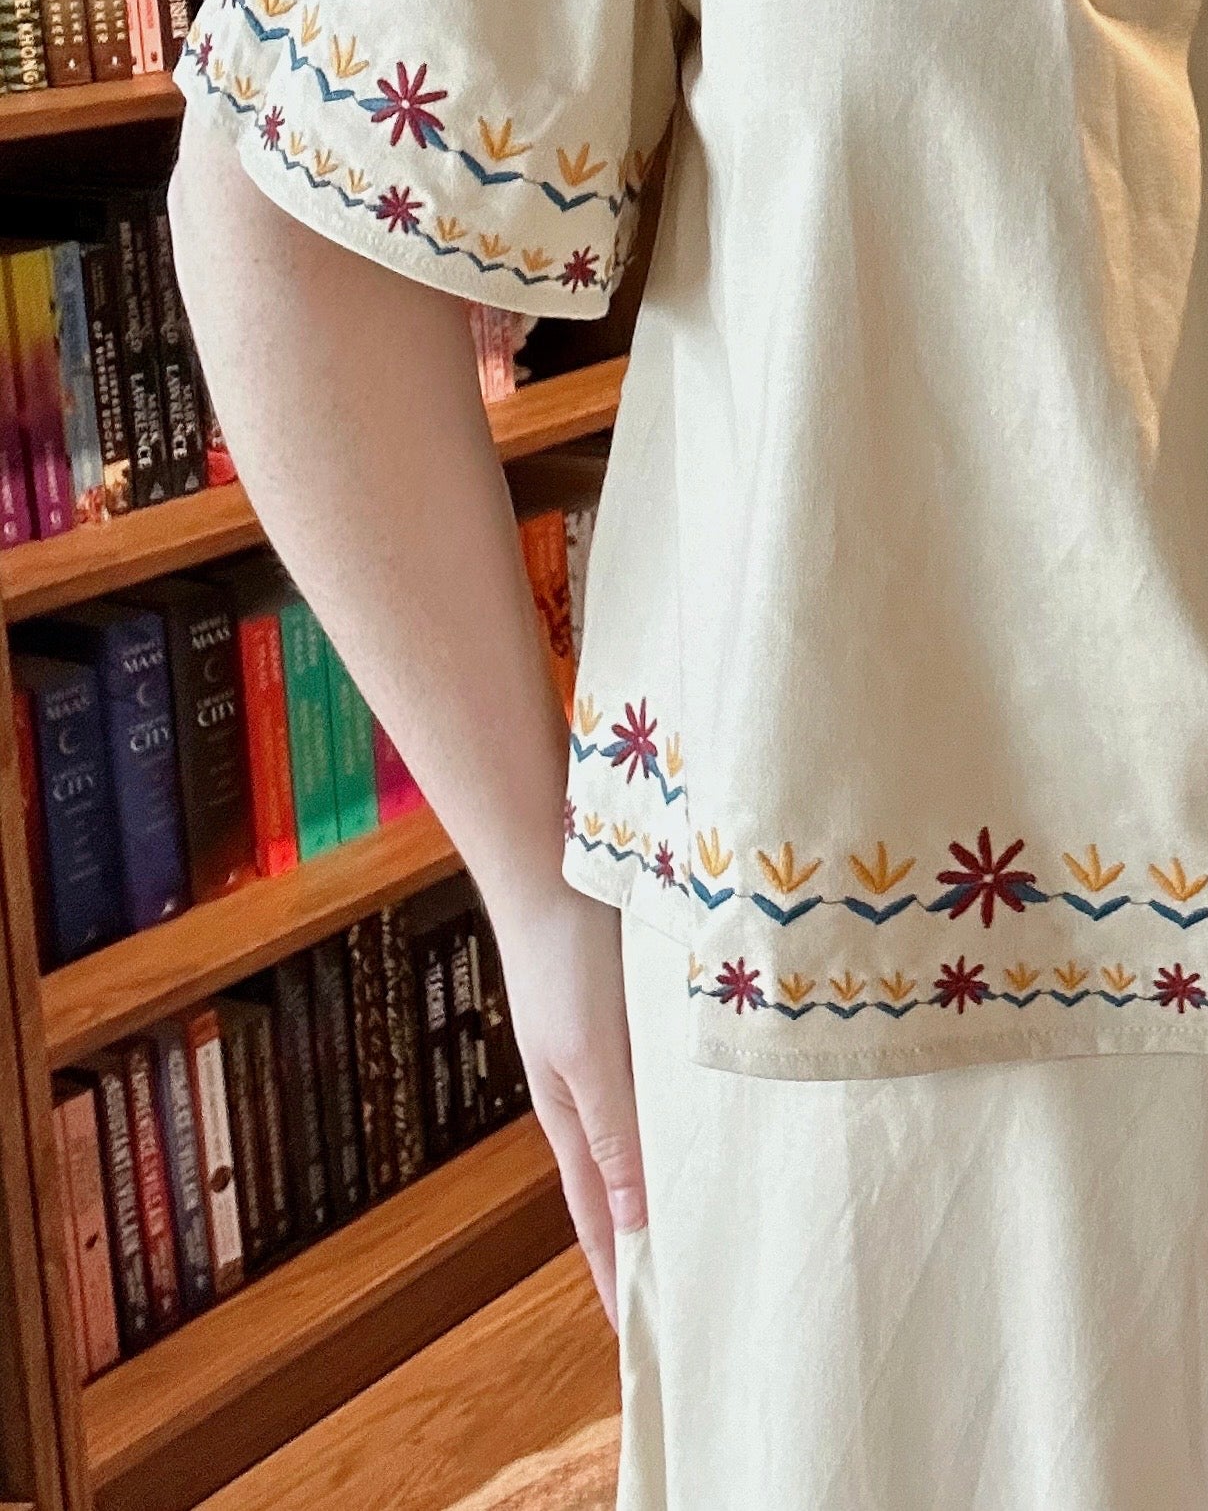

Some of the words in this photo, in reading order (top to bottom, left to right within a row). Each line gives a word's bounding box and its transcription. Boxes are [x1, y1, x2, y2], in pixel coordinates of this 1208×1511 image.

[68, 0, 84, 43] LIKE
[112, 0, 127, 40] LIKE
[16, 23, 39, 83] KHONG
[128, 372, 152, 469] LAWRENCE
[163, 364, 188, 460] LAWRENCE
[191, 627, 232, 651] MAAS
[122, 649, 165, 674] MAAS
[197, 701, 237, 730] CITY
[128, 726, 172, 756] CITY
[52, 773, 95, 802] CITY
